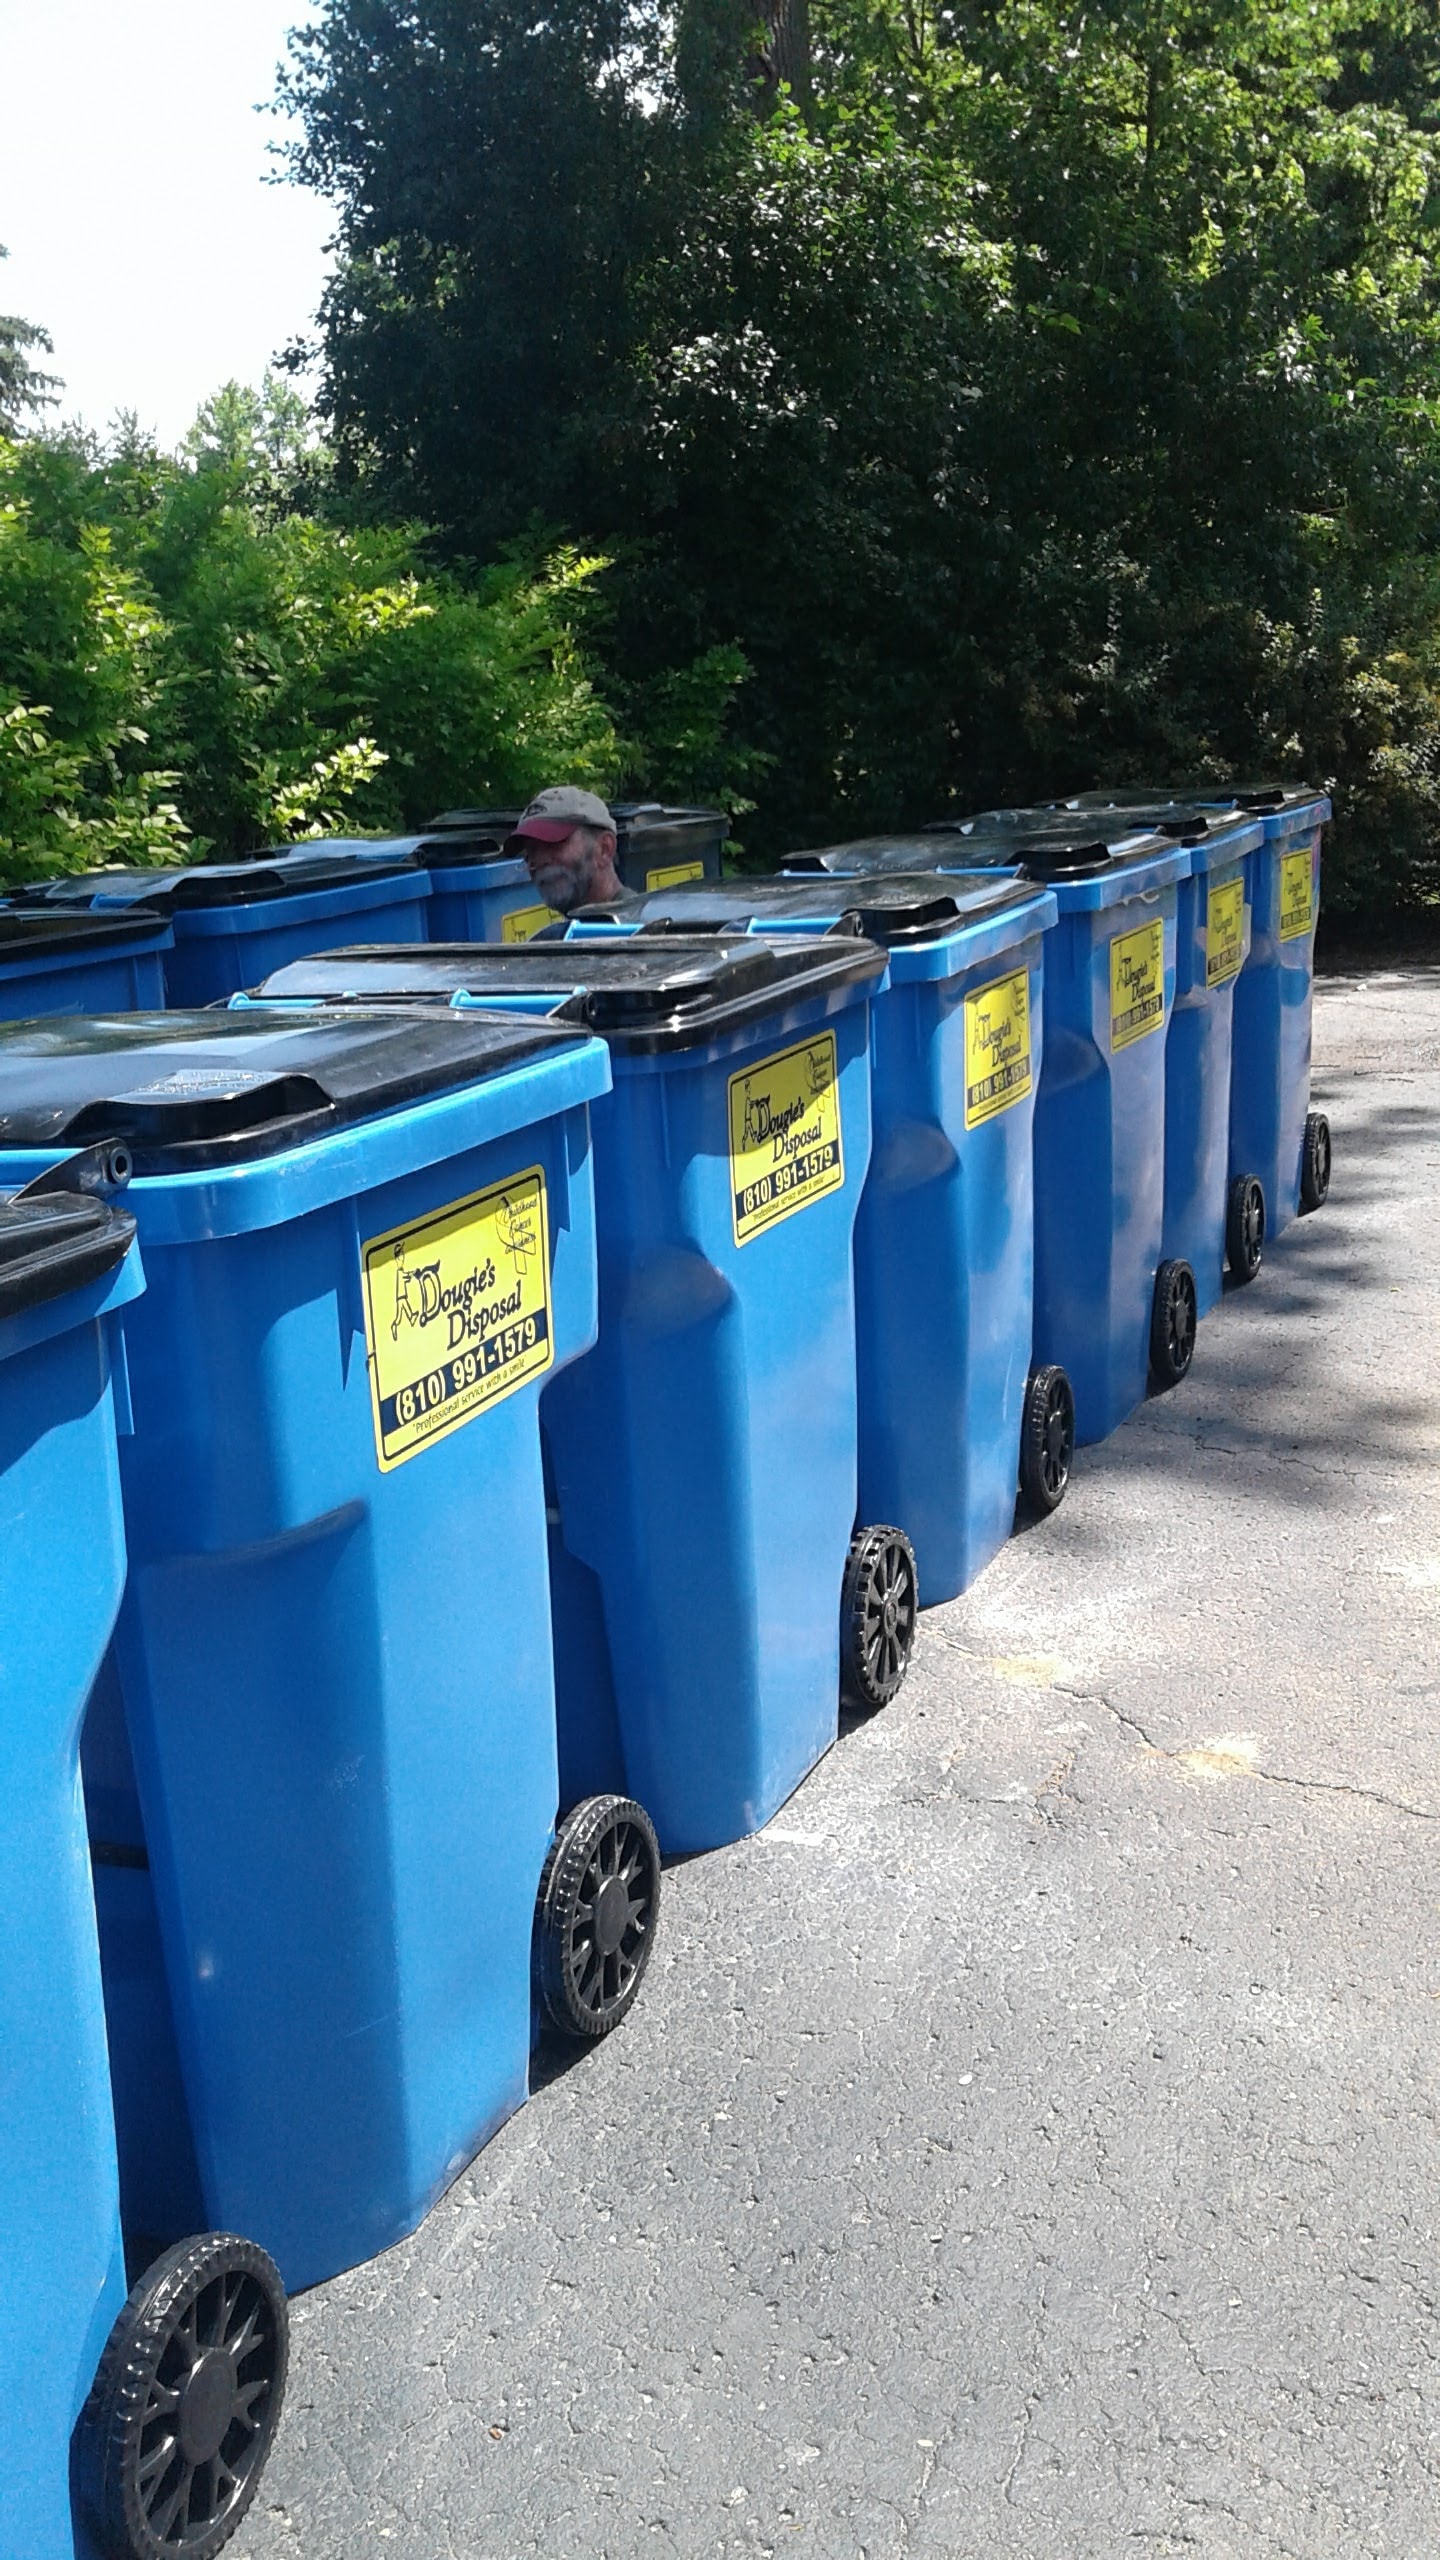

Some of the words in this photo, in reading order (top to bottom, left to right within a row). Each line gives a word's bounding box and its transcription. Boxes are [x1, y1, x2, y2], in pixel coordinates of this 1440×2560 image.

[757, 1094, 805, 1143] Dougie's
[773, 1116, 822, 1163] Disposal
[743, 1176, 772, 1214] (810)
[776, 1146, 833, 1193] 991-1579
[418, 1258, 495, 1327] Dougie's
[447, 1279, 521, 1351] Disposal
[396, 1369, 446, 1425] (810)
[452, 1317, 536, 1390] 991-1579
[461, 1383, 484, 1406] service
[486, 1371, 502, 1389] with
